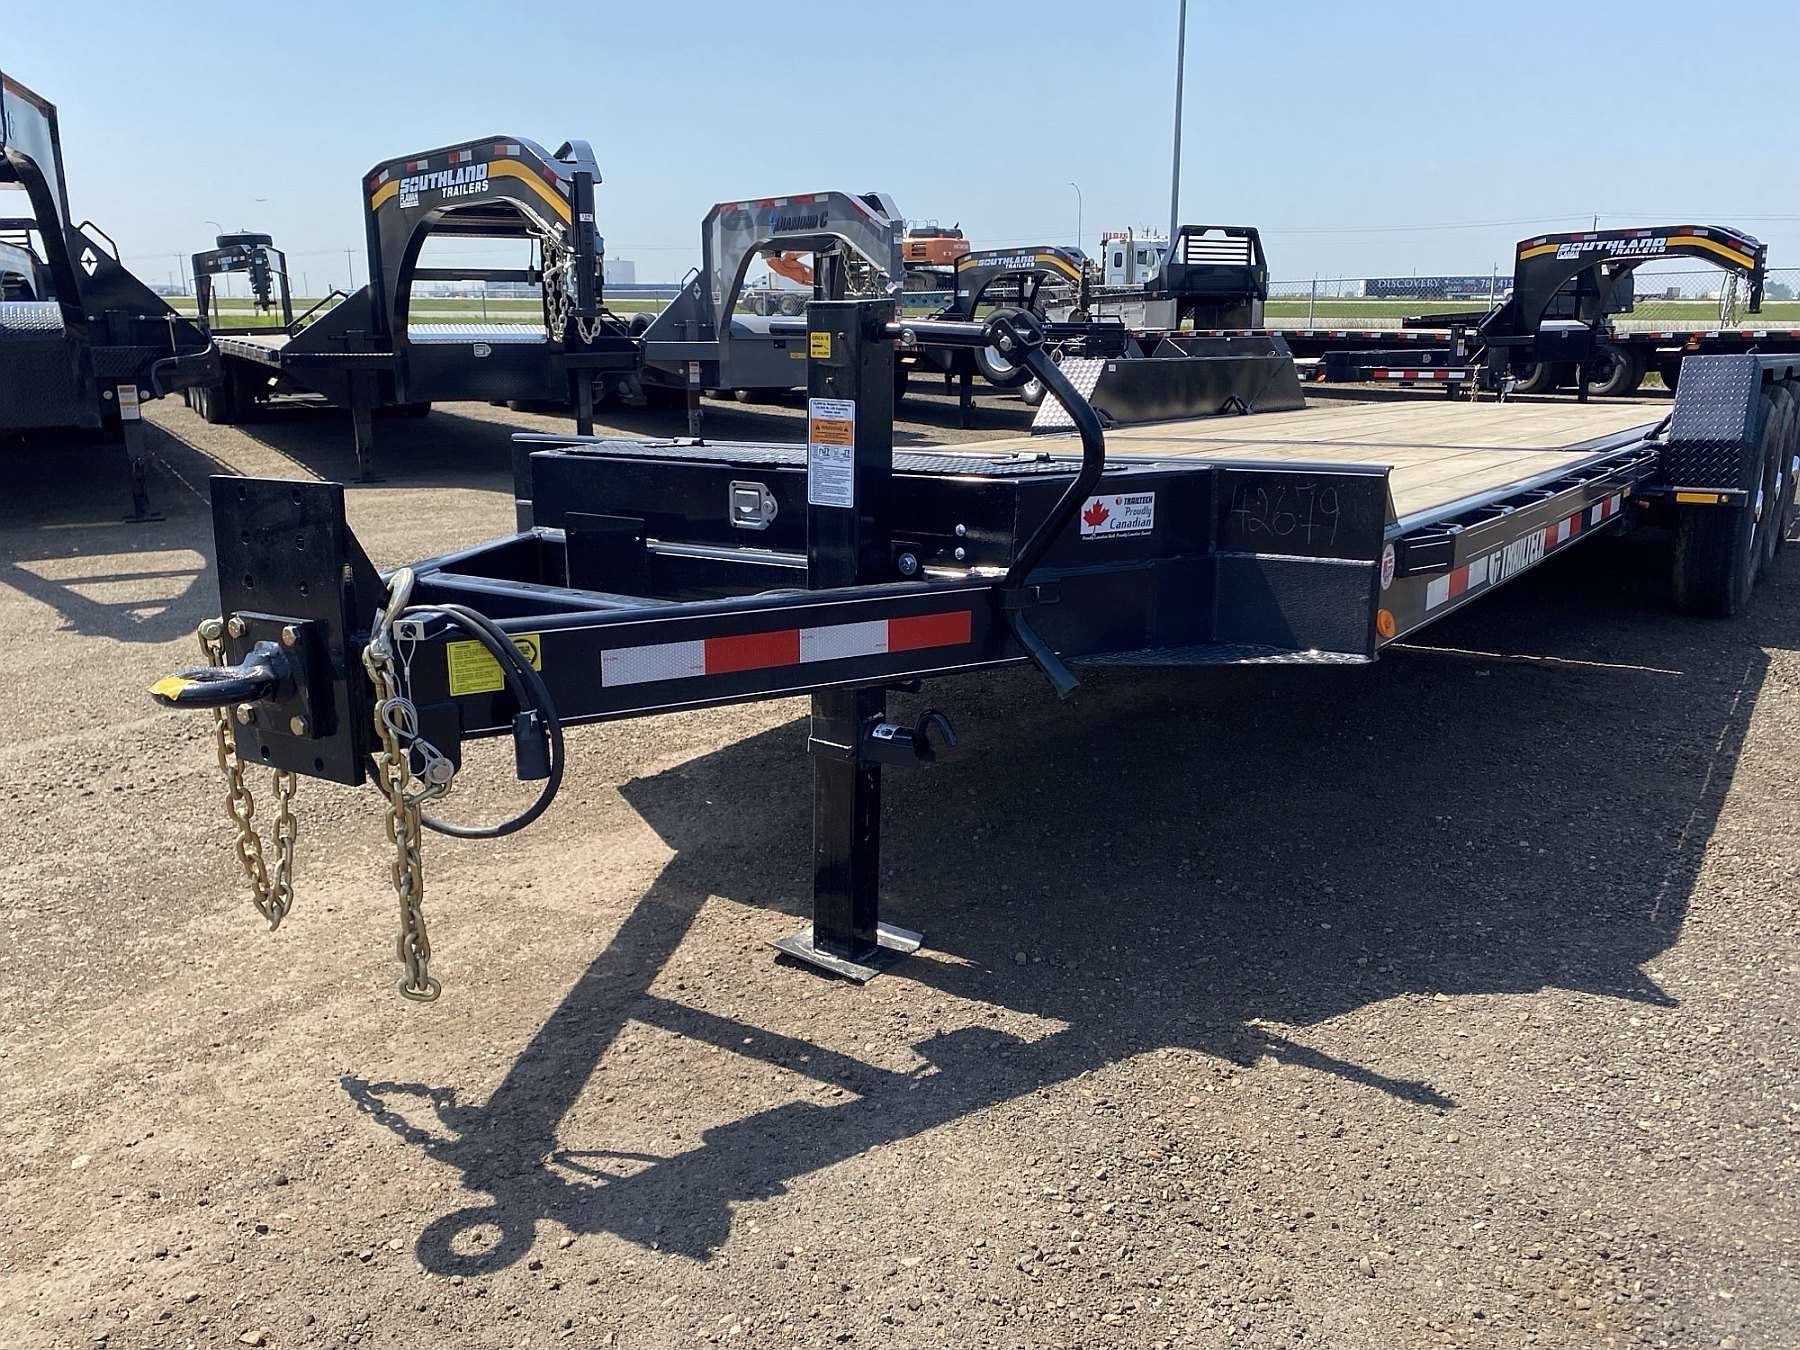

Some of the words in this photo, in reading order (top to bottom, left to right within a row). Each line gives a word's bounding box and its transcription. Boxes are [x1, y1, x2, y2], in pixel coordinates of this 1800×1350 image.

[400, 163, 488, 194] SOUTHLAND
[442, 180, 489, 198] TRAILERS
[773, 214, 819, 234] DIAMOND
[820, 210, 829, 228] C
[1559, 237, 1667, 252] SOUTHLAND
[1609, 246, 1666, 256] TRAILERS
[977, 255, 1035, 267] SOUTHLAND
[1378, 278, 1441, 288] DISCOVERY
[1124, 495, 1153, 506] TRAILTECH
[1125, 505, 1152, 518] Proudly
[1231, 483, 1341, 545] 42679
[1110, 517, 1152, 530] Canadian
[1501, 528, 1548, 580] TRAILTECH
